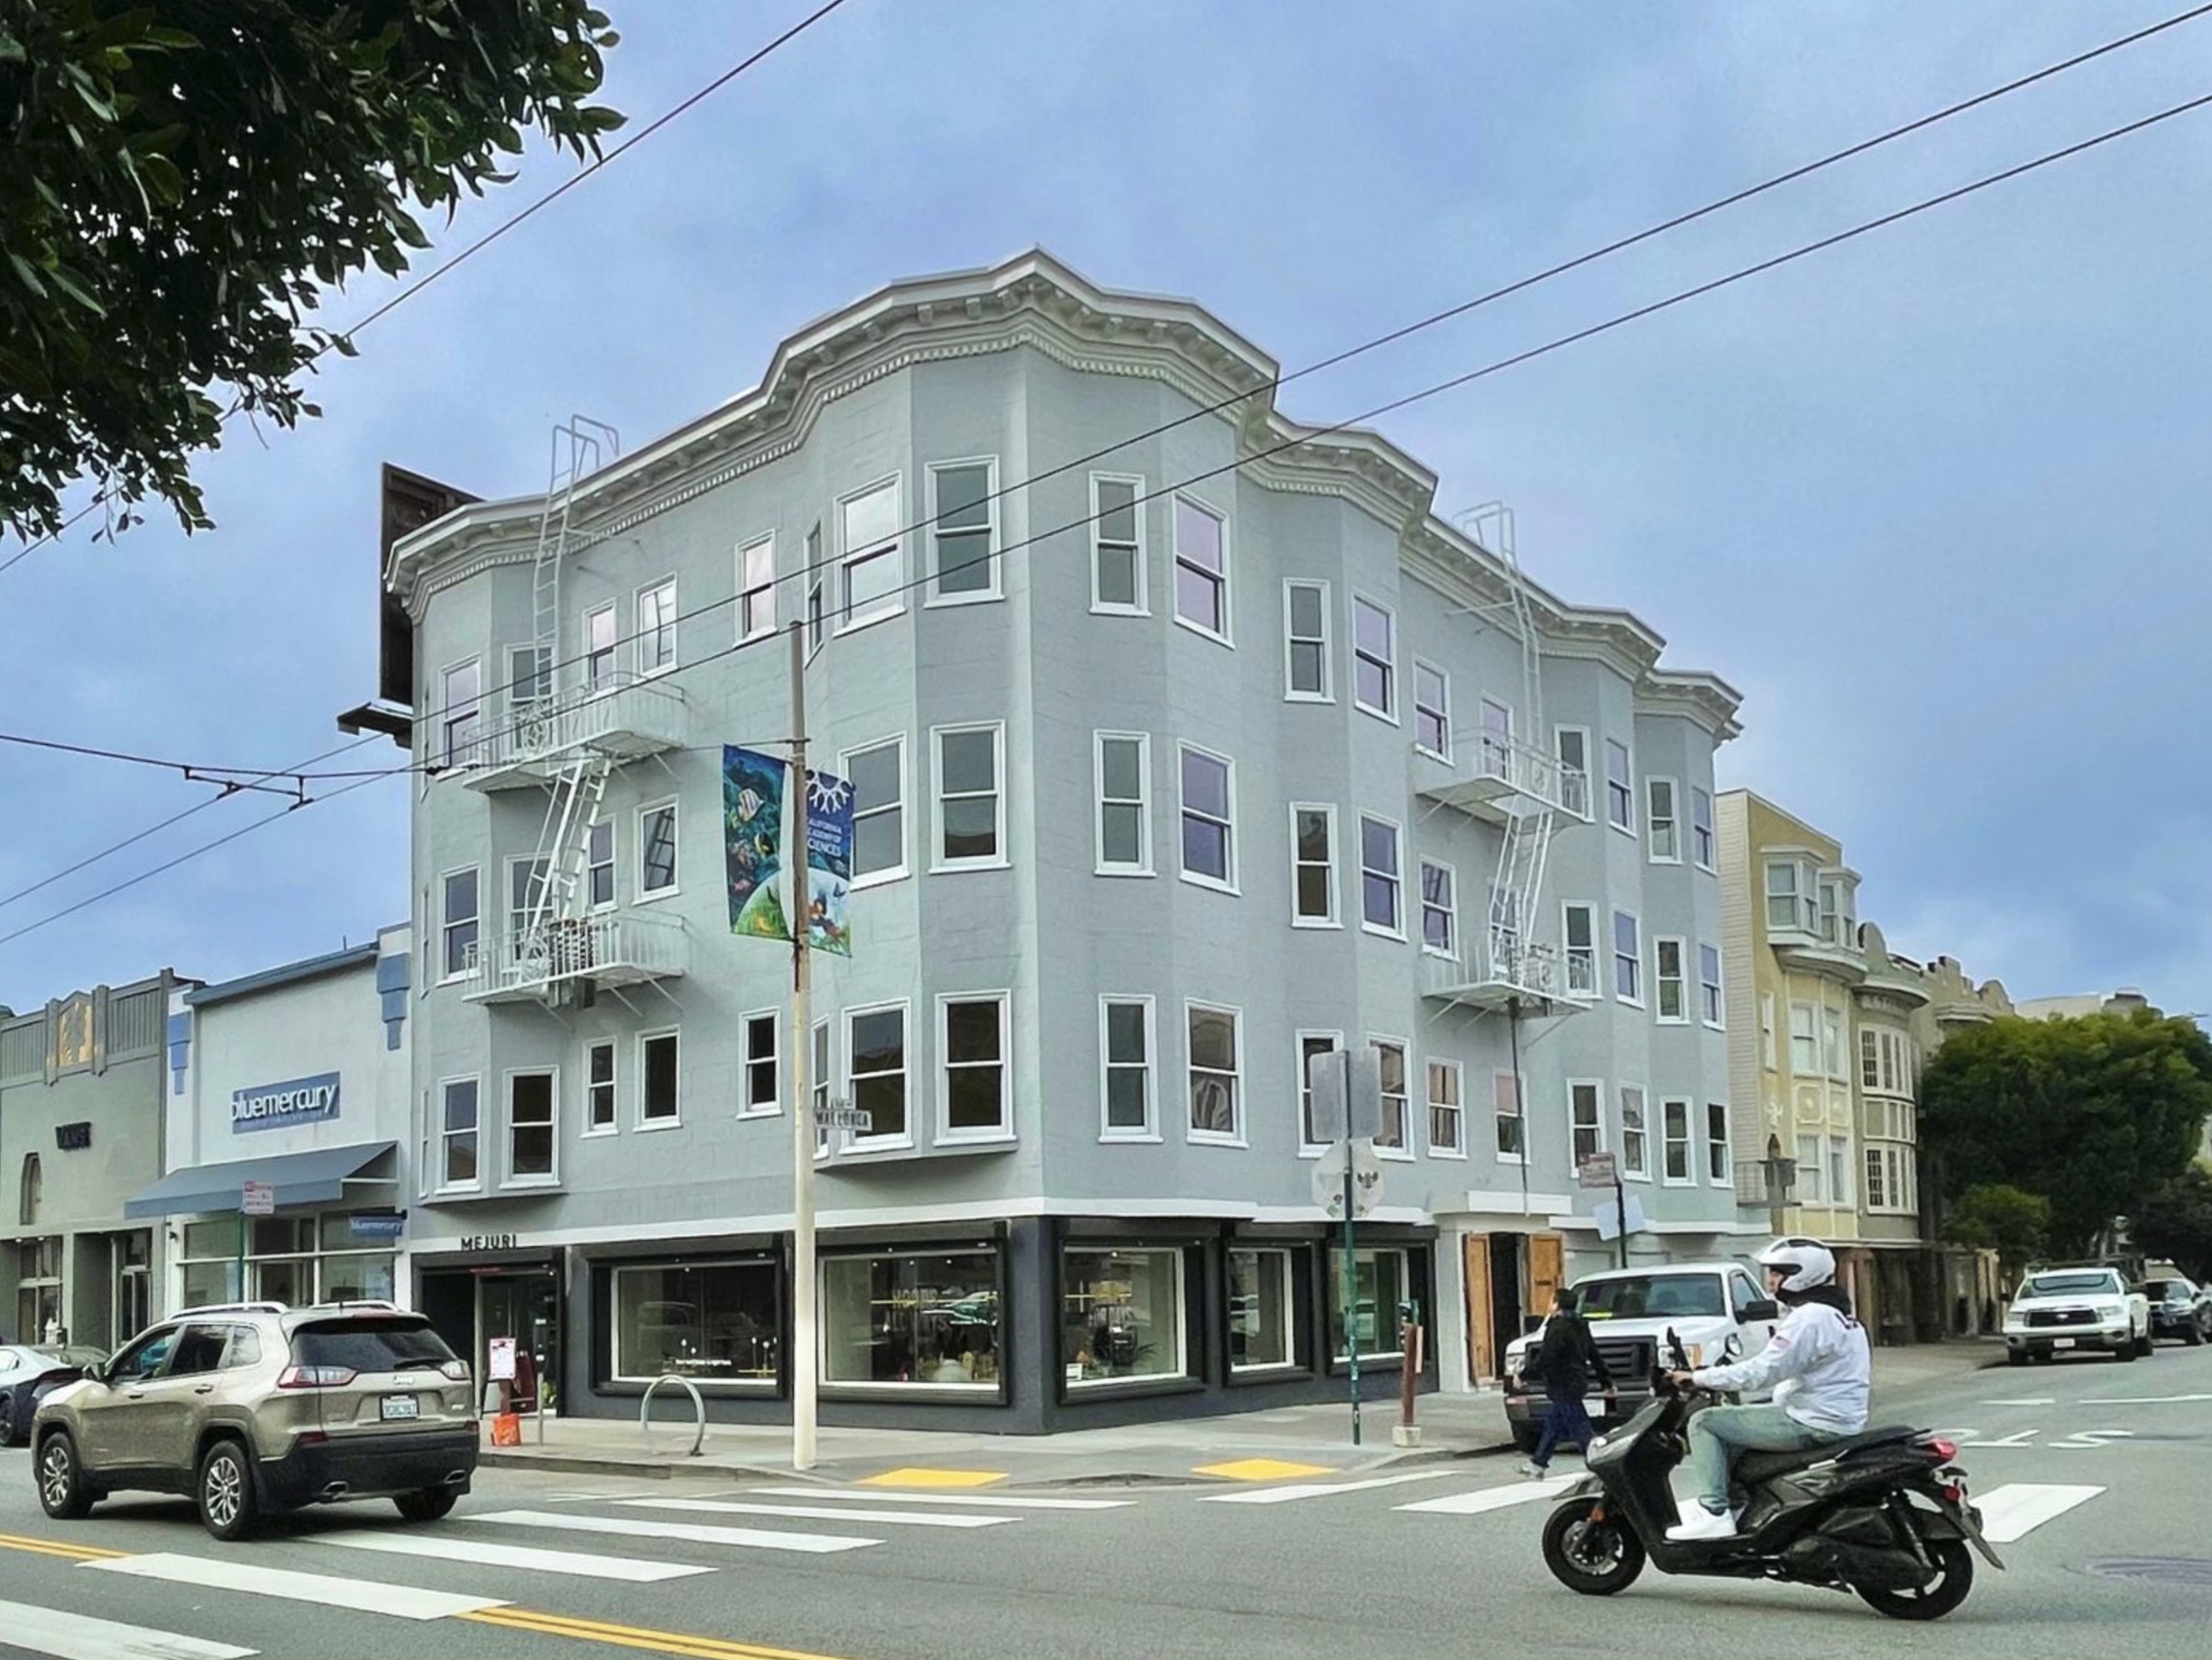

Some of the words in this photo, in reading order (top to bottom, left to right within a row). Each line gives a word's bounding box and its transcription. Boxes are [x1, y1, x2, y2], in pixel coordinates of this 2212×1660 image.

[807, 818, 842, 835] ALIFORNIA
[807, 837, 842, 857] CIENCES
[231, 1084, 337, 1120] bluemercury
[461, 1233, 516, 1252] MEJURI
